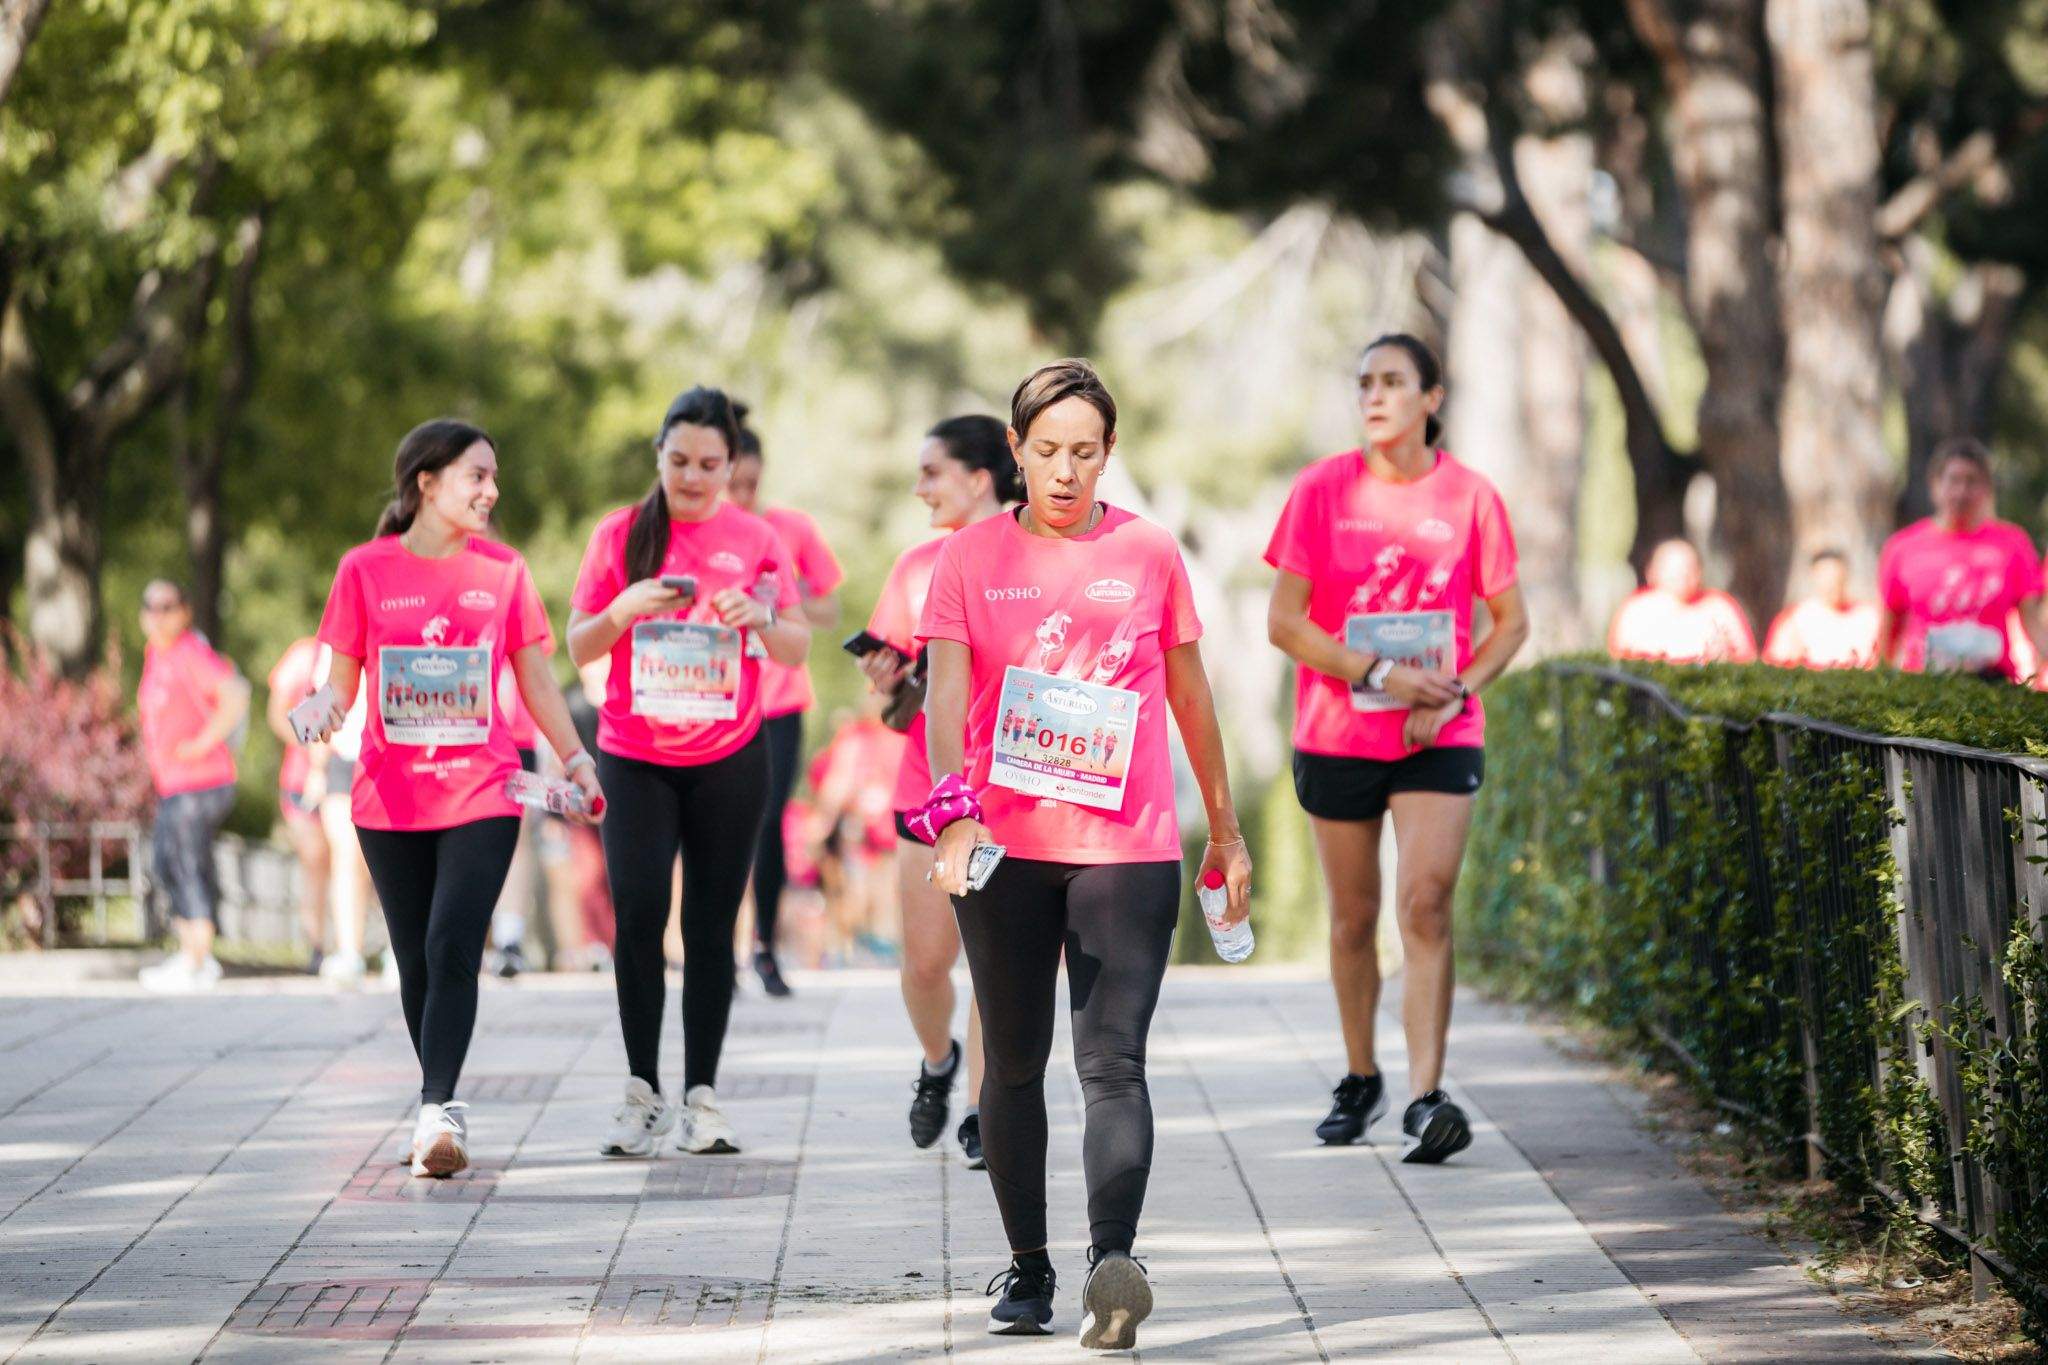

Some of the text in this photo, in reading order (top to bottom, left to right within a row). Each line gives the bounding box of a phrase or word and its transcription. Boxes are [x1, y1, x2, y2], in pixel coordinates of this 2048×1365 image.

[984, 586, 1042, 601] OYSHO
[380, 595, 426, 611] OYSHO
[667, 663, 707, 681] 016
[415, 690, 456, 708] 016
[1045, 692, 1094, 713] ASTURIANA
[1038, 729, 1087, 756] 016
[1042, 753, 1072, 768] 32828
[1003, 768, 1041, 787] OYSHO
[1006, 756, 1033, 769] CARRERA
[1033, 762, 1043, 771] DE
[1043, 764, 1054, 774] LA
[1053, 766, 1076, 778] MUJER
[1080, 773, 1108, 784] MADRID
[1066, 785, 1106, 799] Santander
